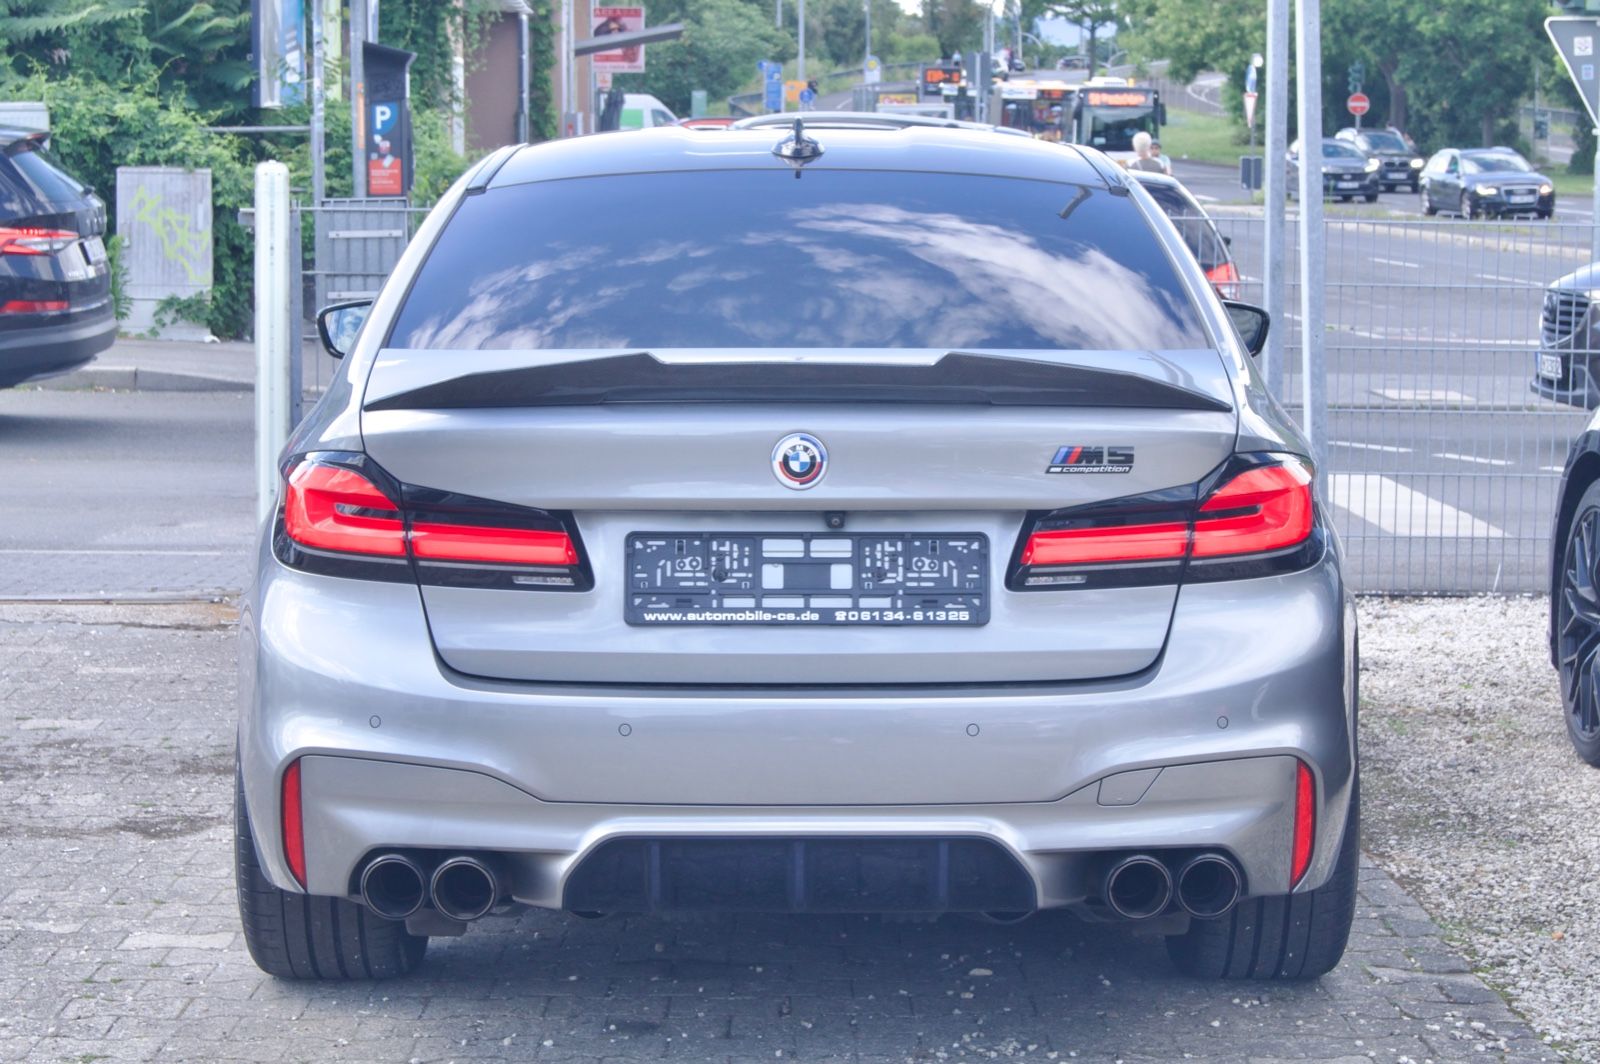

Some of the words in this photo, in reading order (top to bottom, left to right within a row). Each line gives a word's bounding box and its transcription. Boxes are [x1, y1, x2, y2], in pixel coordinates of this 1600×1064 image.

[375, 105, 391, 130] P
[784, 444, 815, 458] BMW
[1061, 466, 1131, 475] competition
[643, 610, 820, 622] www.automobile-cs.de
